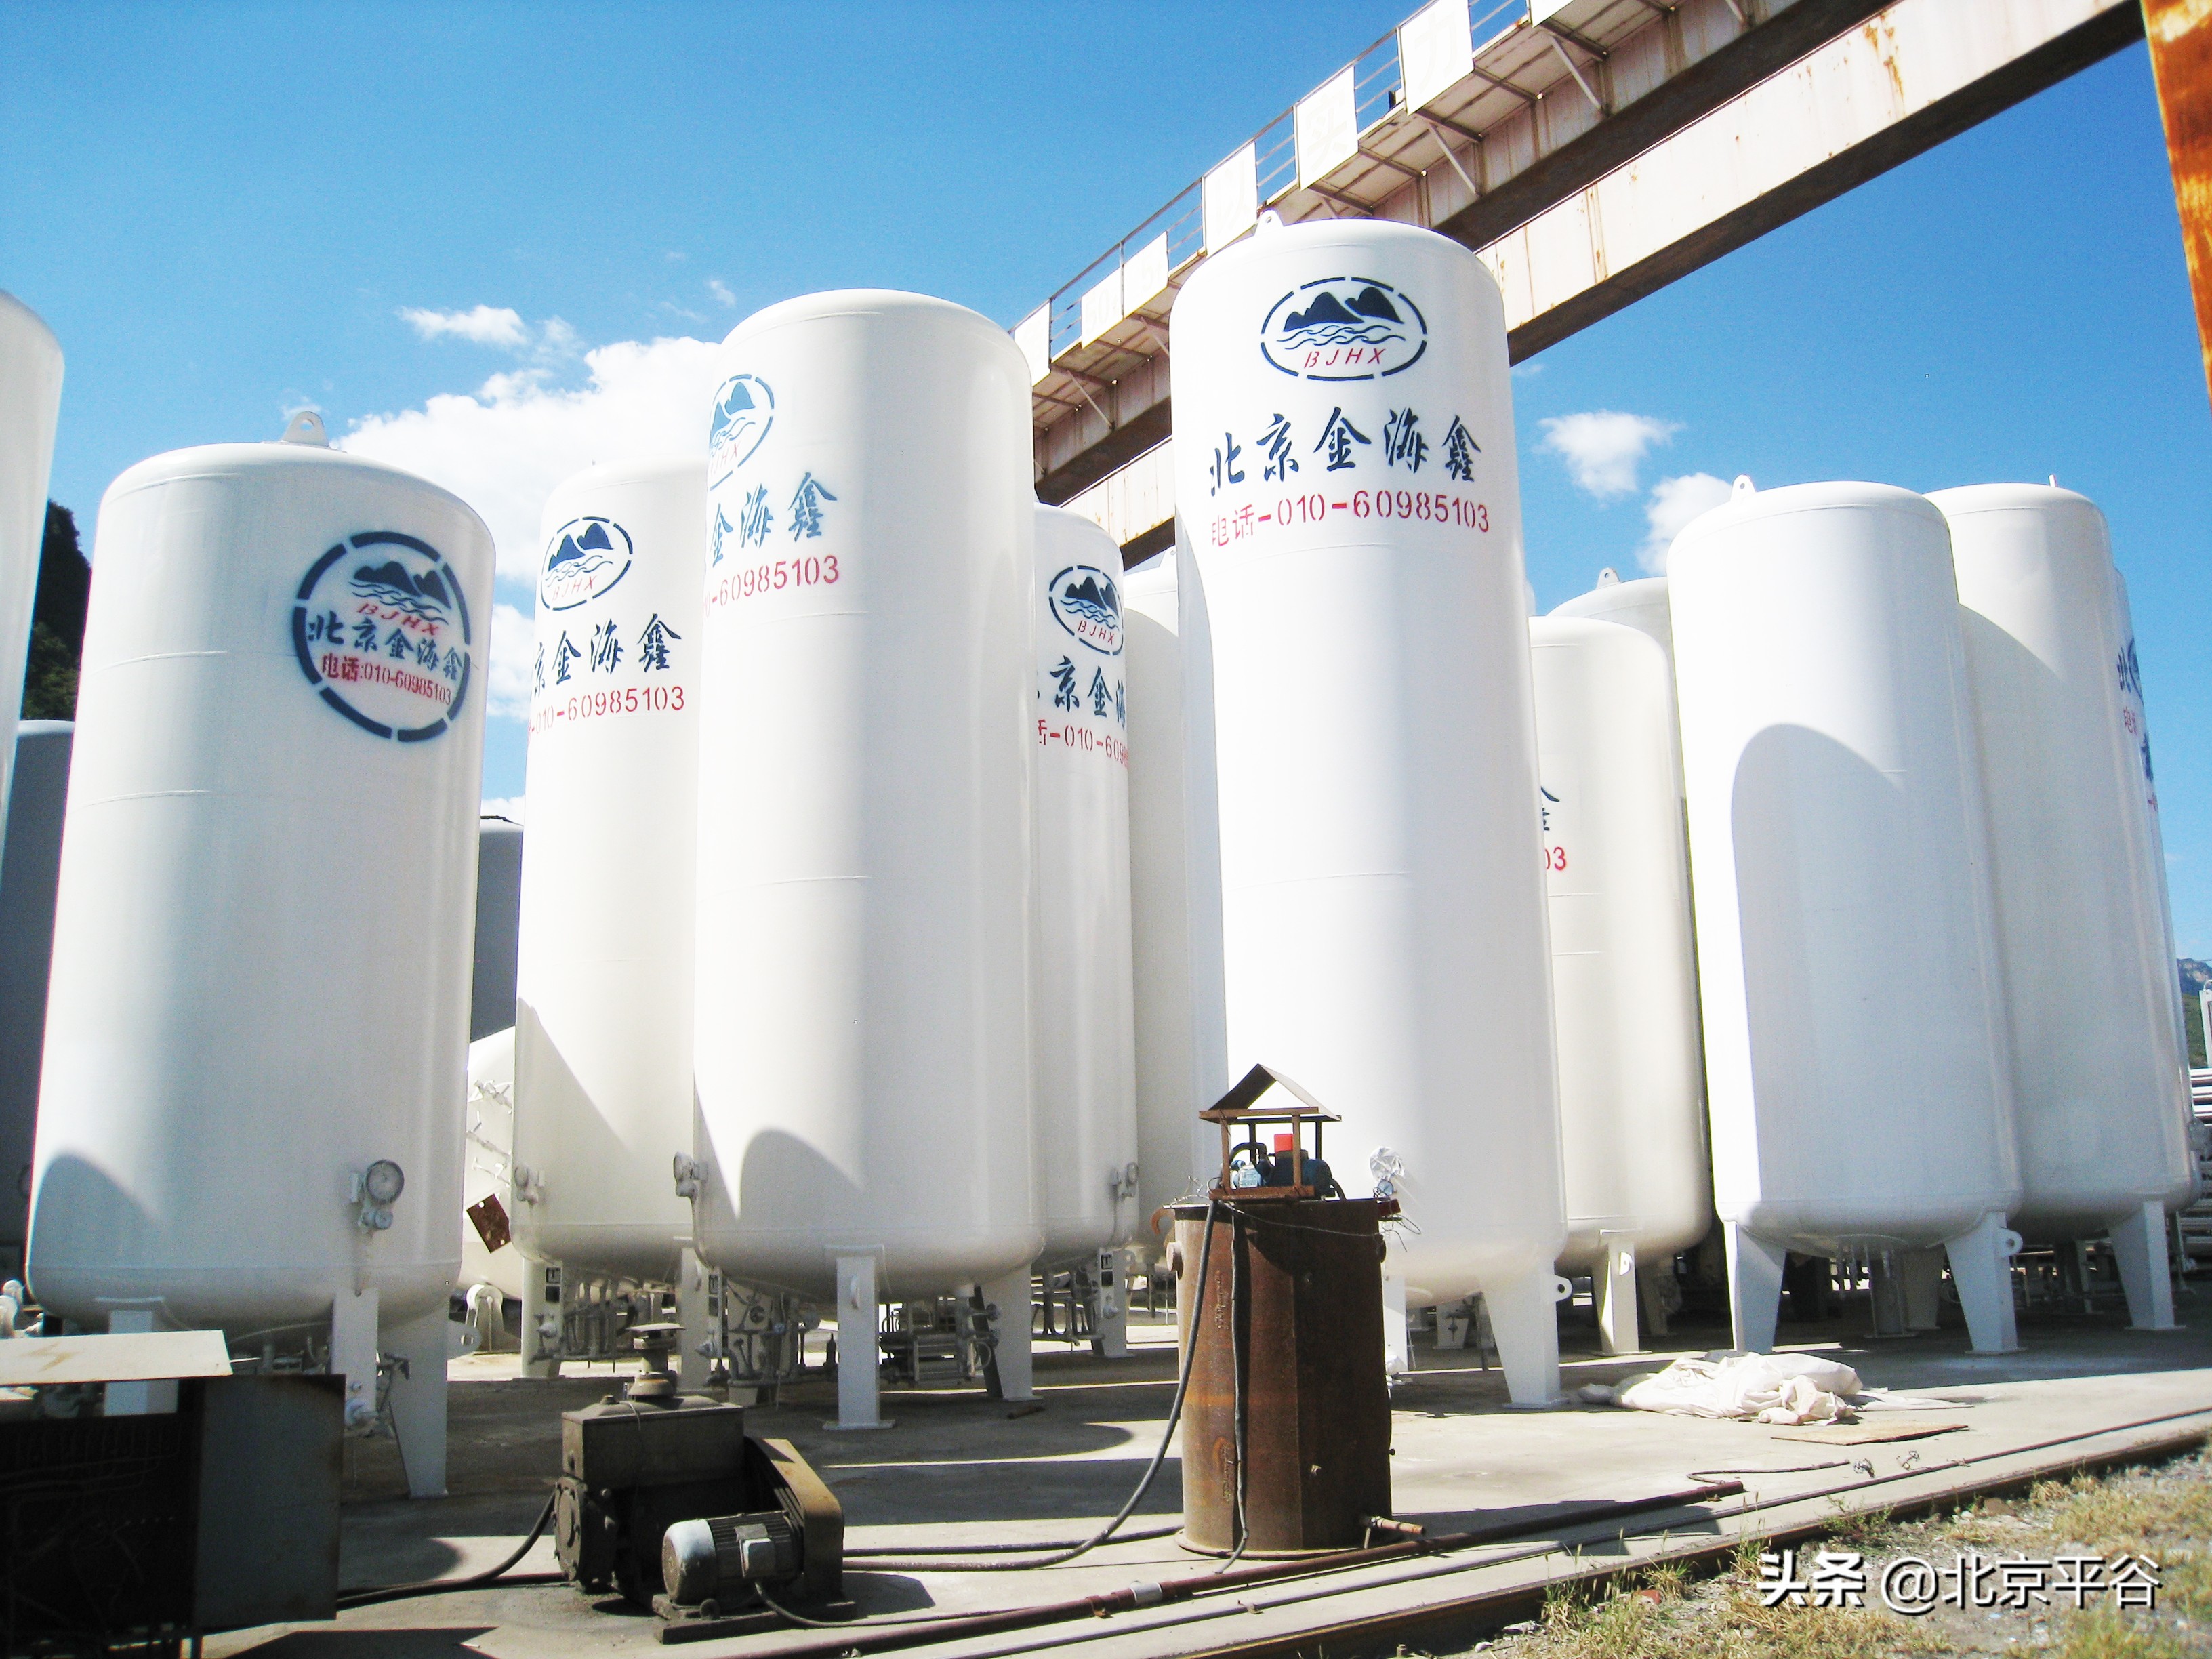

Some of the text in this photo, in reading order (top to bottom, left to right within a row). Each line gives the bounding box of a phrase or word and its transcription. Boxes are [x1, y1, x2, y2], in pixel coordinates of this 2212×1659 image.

[1304, 348, 1386, 368] BJHX
[1210, 406, 1482, 497] 北京金海鑫
[1211, 490, 1490, 547] 电话-010-60985103
[552, 575, 597, 602] BJHX
[357, 603, 440, 636] BJHX
[1078, 620, 1114, 645] BJHX
[308, 610, 463, 681] 北京金海鑫
[528, 686, 684, 744] -010-60985103
